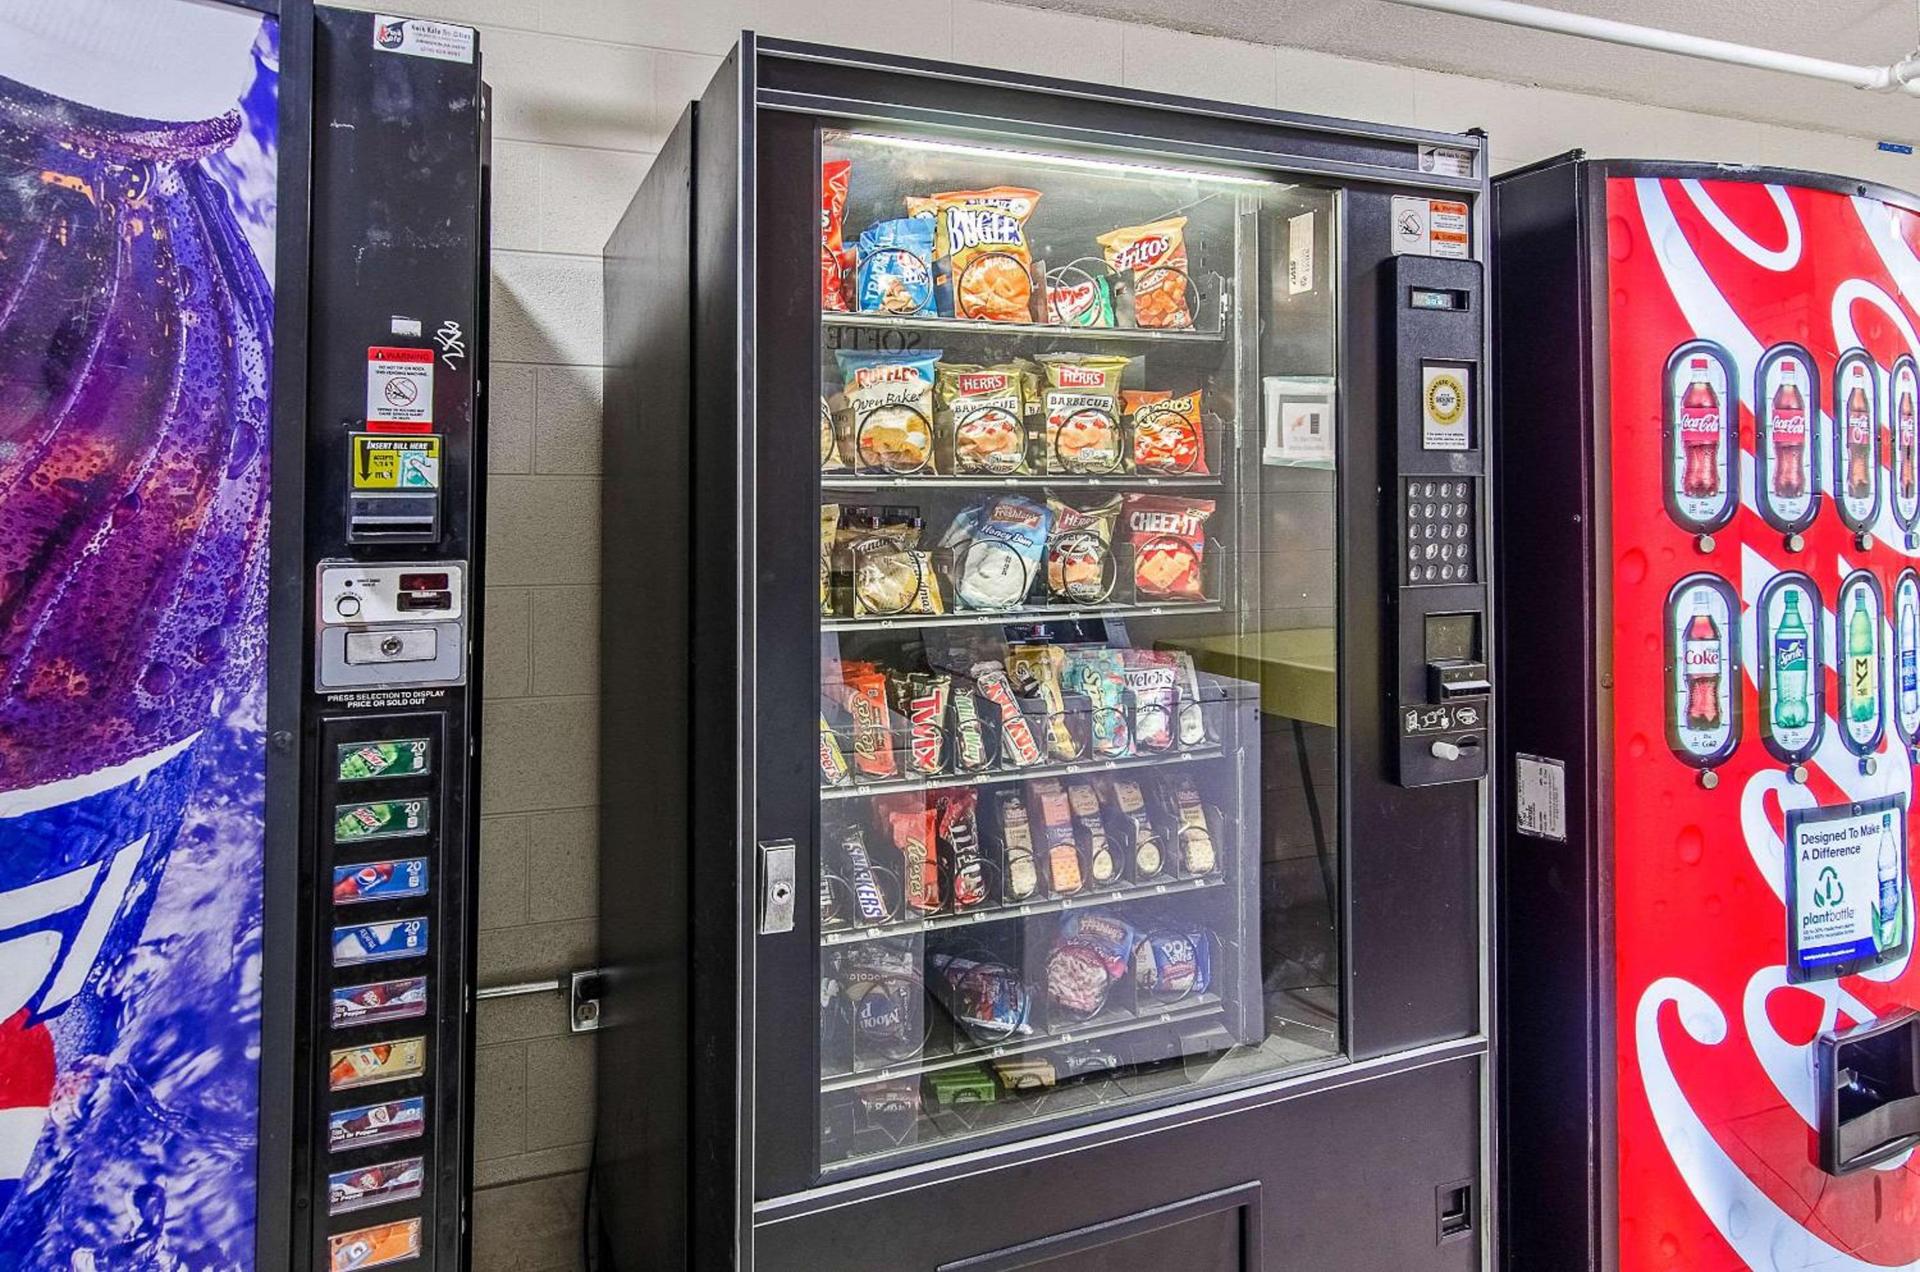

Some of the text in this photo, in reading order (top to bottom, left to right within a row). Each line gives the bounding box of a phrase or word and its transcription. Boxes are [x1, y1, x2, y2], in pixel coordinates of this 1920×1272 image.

[1113, 235, 1169, 270] Fritos
[1050, 396, 1110, 409] BARBECUE
[366, 440, 393, 449] INSERT
[980, 524, 1012, 541] Honey
[1685, 650, 1719, 665] Coke
[1124, 670, 1172, 687] Welch's
[327, 694, 354, 702] PRESS
[356, 692, 400, 701] SELECTION
[413, 690, 445, 698] DISPLAY
[911, 687, 943, 770] TWIX
[410, 741, 426, 753] 20
[404, 802, 420, 813] 20
[1801, 824, 1880, 846] Designed To Make
[1802, 844, 1861, 861] A Difference
[406, 861, 422, 872] 20
[404, 921, 420, 933] 20
